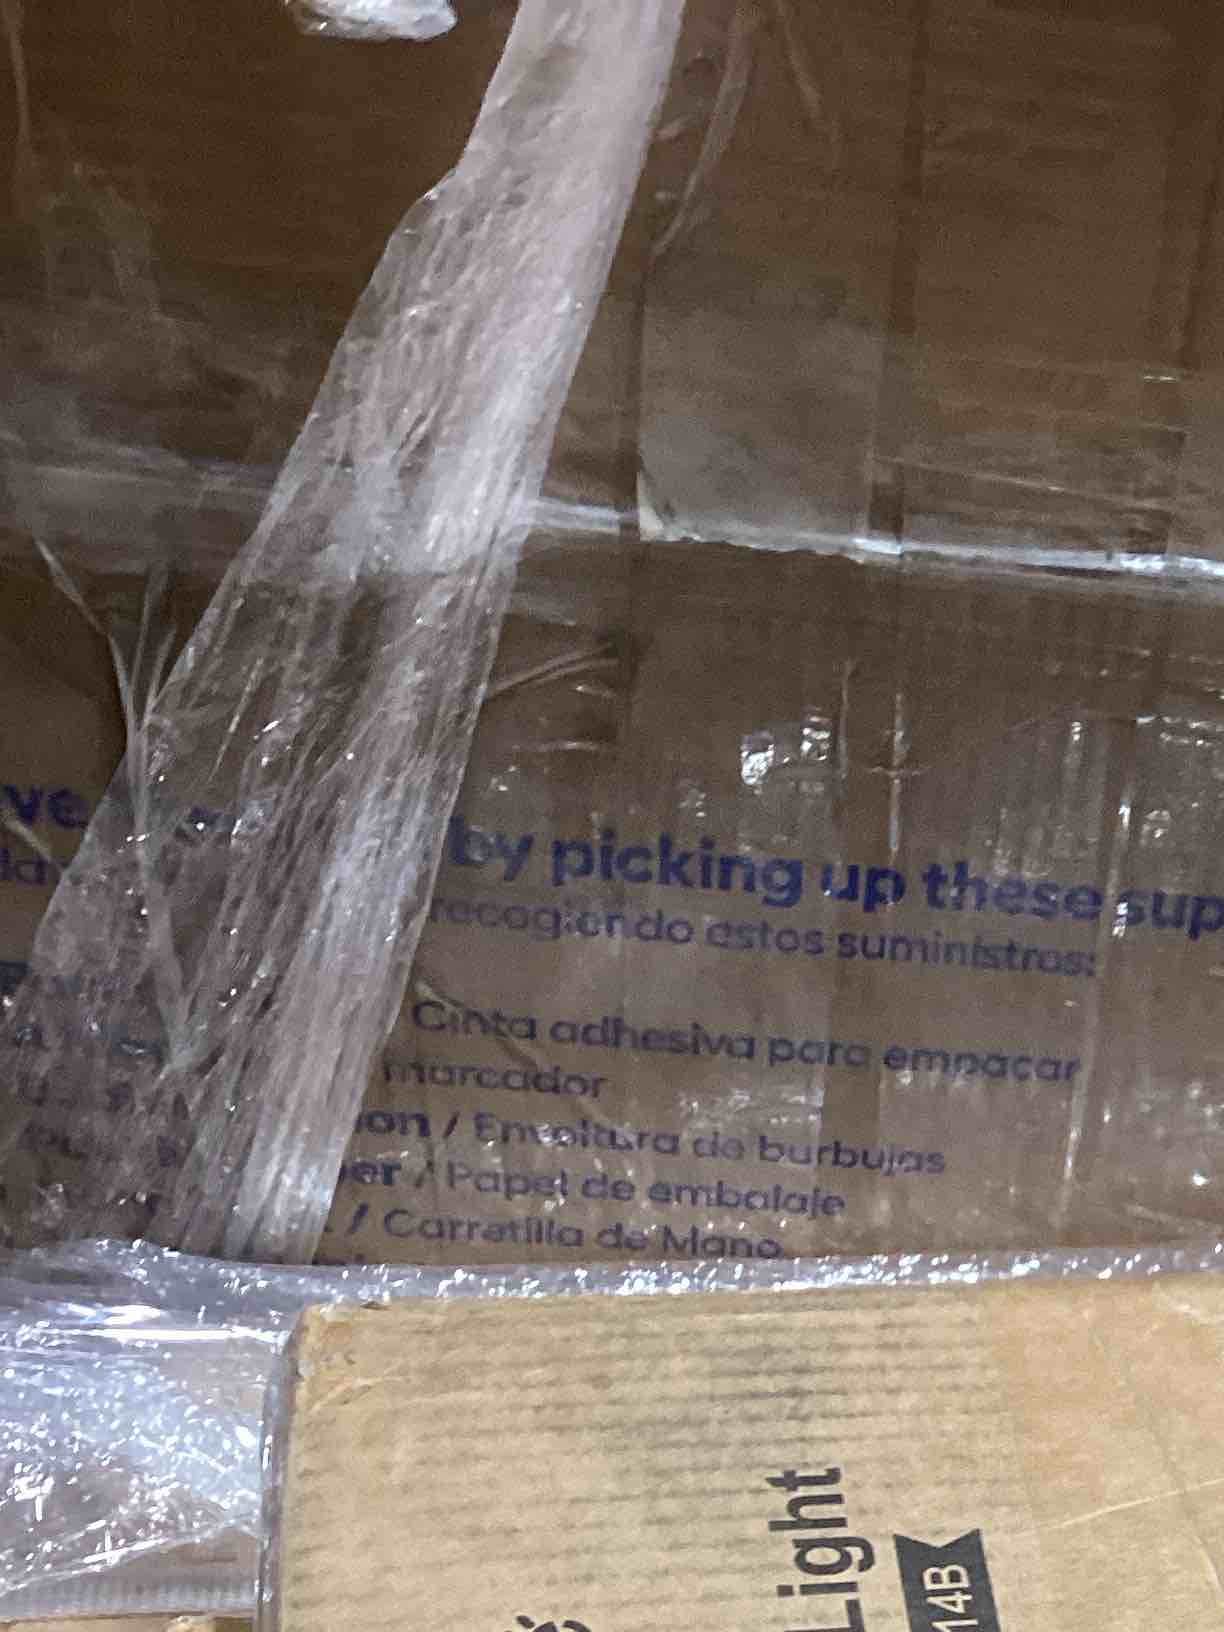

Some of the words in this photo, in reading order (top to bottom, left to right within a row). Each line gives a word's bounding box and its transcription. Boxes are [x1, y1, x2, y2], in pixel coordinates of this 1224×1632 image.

[449, 815, 534, 882] by
[551, 826, 804, 908] picking
[821, 862, 908, 913] up
[922, 860, 1105, 920] these
[706, 919, 826, 956] estos
[837, 929, 1097, 977] suministros:
[412, 999, 537, 1040] Cinta
[550, 1014, 755, 1060] adhesiva
[769, 1034, 871, 1068] para
[884, 1044, 1081, 1083] empacar
[693, 1131, 747, 1160] de
[759, 1134, 946, 1177] burbujas
[448, 1160, 569, 1200] Papel
[581, 1171, 636, 1202] de
[648, 1179, 846, 1221] embalaje
[384, 1208, 585, 1248] Carretilla
[597, 1221, 650, 1251] de
[661, 1223, 784, 1260] Mano
